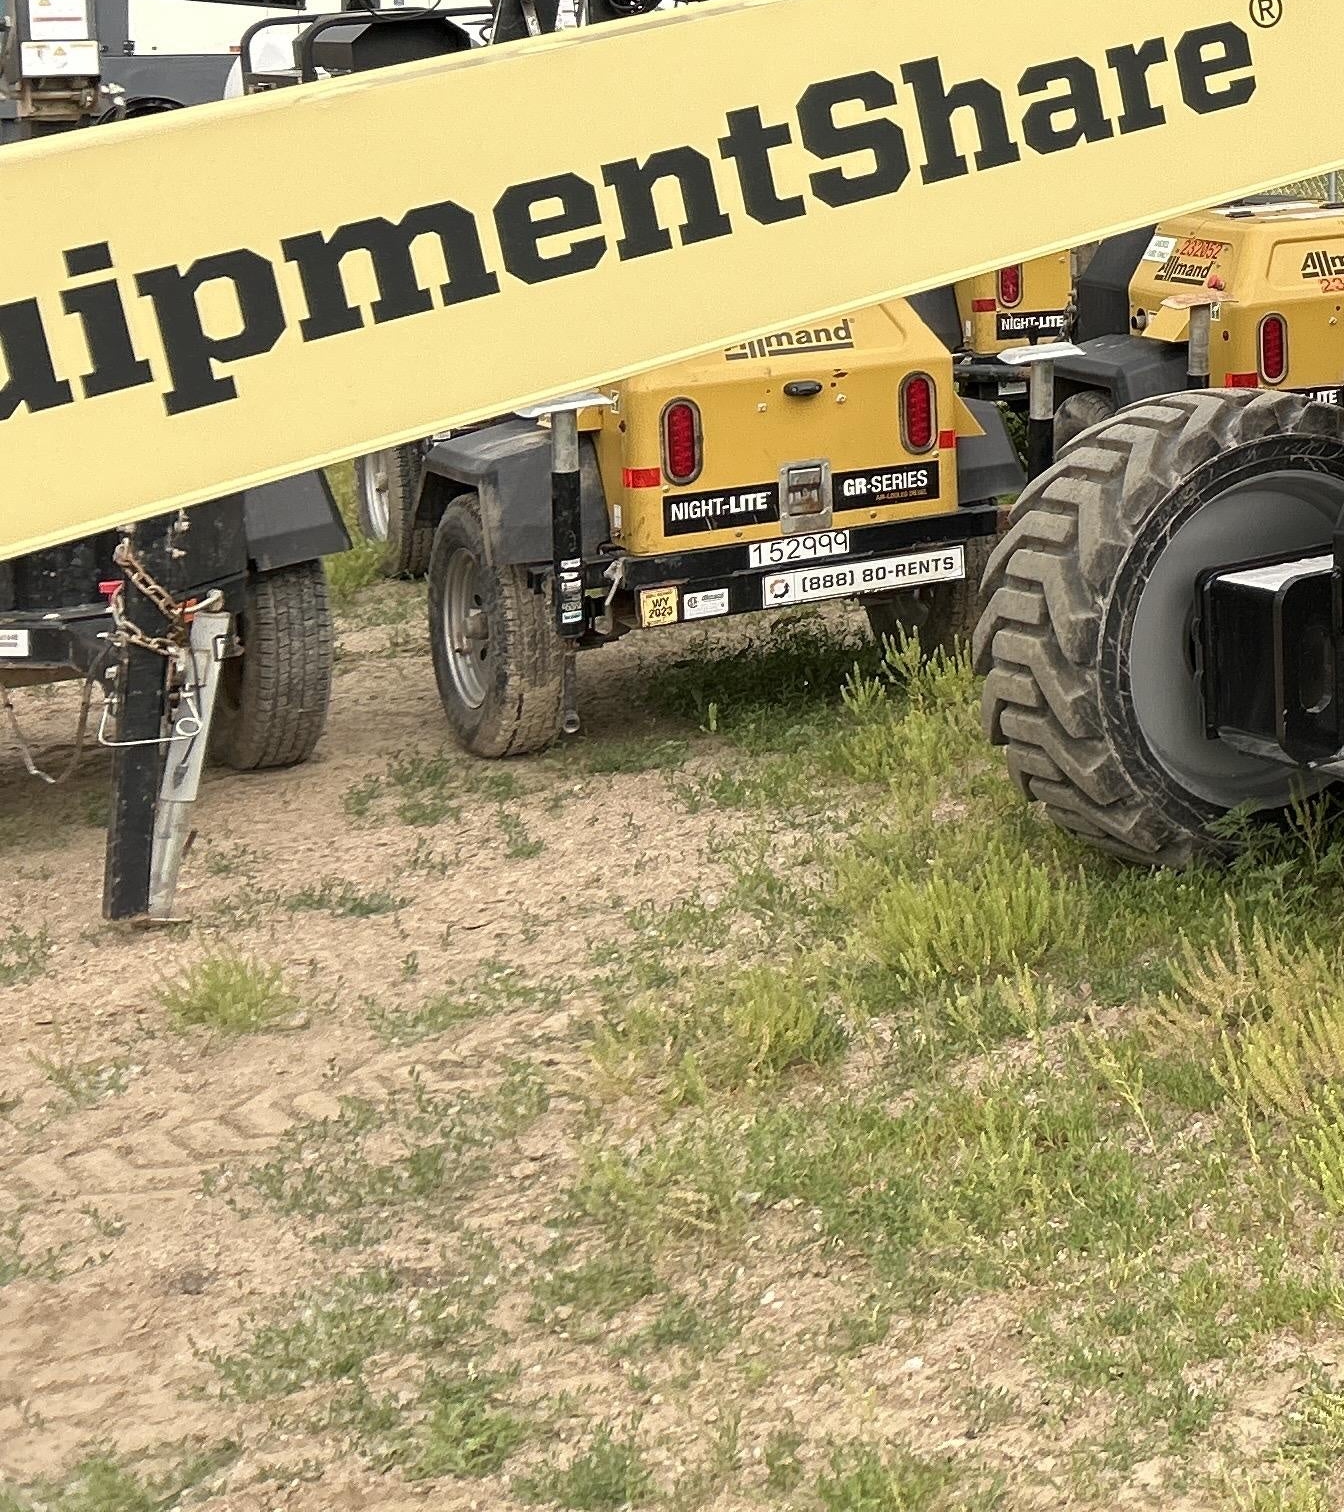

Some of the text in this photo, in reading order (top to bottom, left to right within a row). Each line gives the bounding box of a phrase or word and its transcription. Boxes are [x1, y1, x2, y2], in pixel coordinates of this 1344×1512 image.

[724, 319, 853, 358] llmand
[843, 469, 928, 497] GR-SERIES
[753, 531, 848, 564] 152999
[802, 557, 954, 592] (888) 80-RENTS
[652, 597, 670, 609] WY
